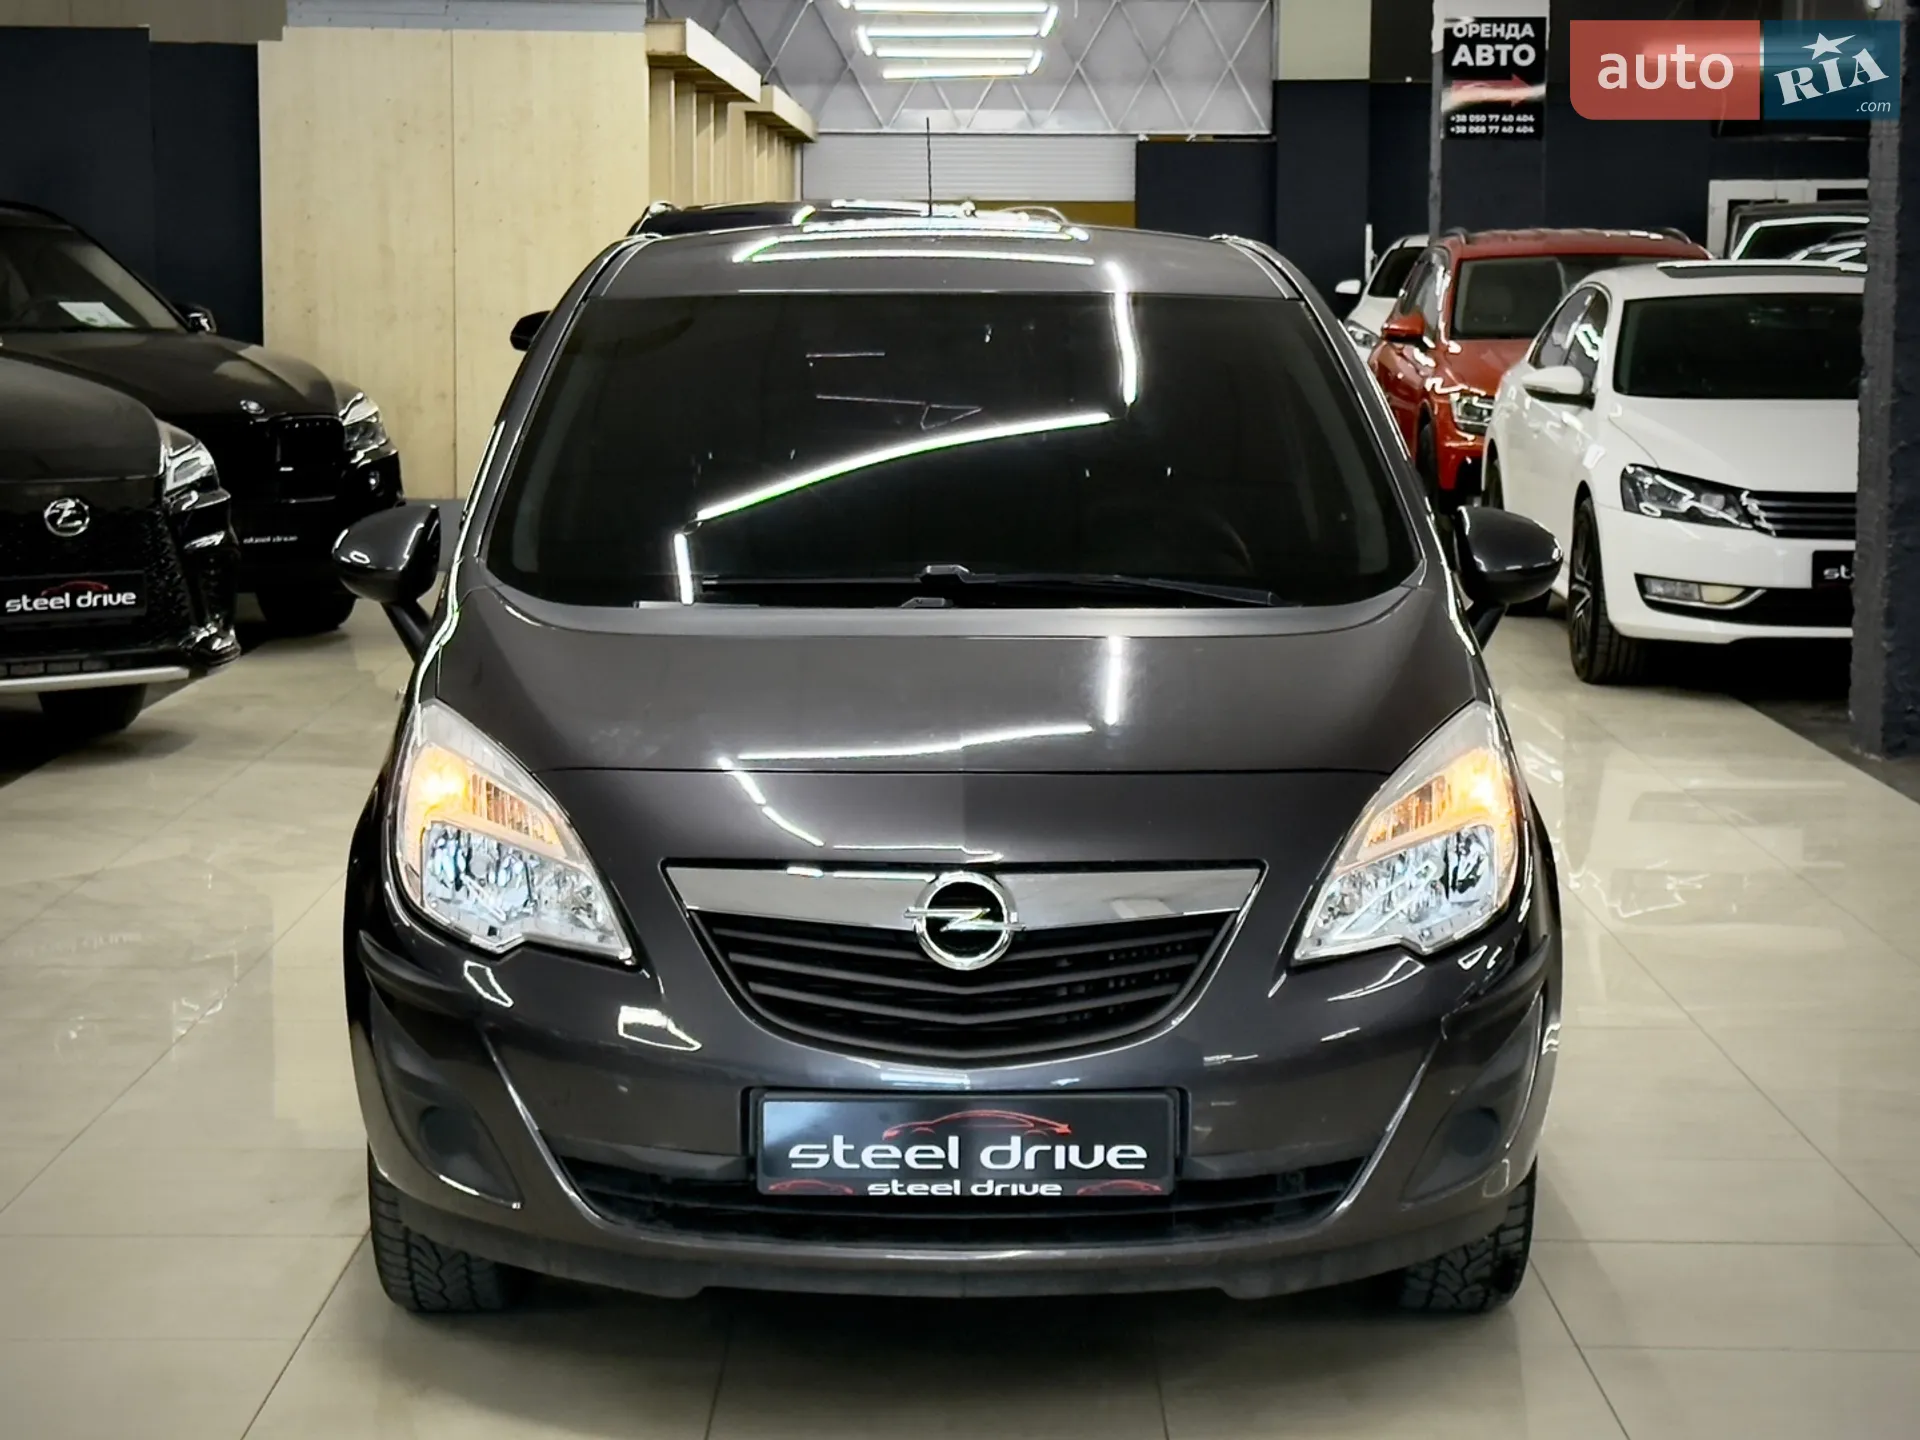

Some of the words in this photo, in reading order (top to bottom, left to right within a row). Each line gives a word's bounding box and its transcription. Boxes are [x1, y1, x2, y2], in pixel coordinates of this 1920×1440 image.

[1452, 22, 1535, 40] ОРЕНДА
[1451, 43, 1536, 67] АВТО
[5, 592, 71, 613] steel
[76, 590, 137, 608] drive
[788, 1135, 959, 1169] steel
[979, 1136, 1147, 1170] drive
[867, 1179, 961, 1196] steel
[970, 1179, 1063, 1196] drive
